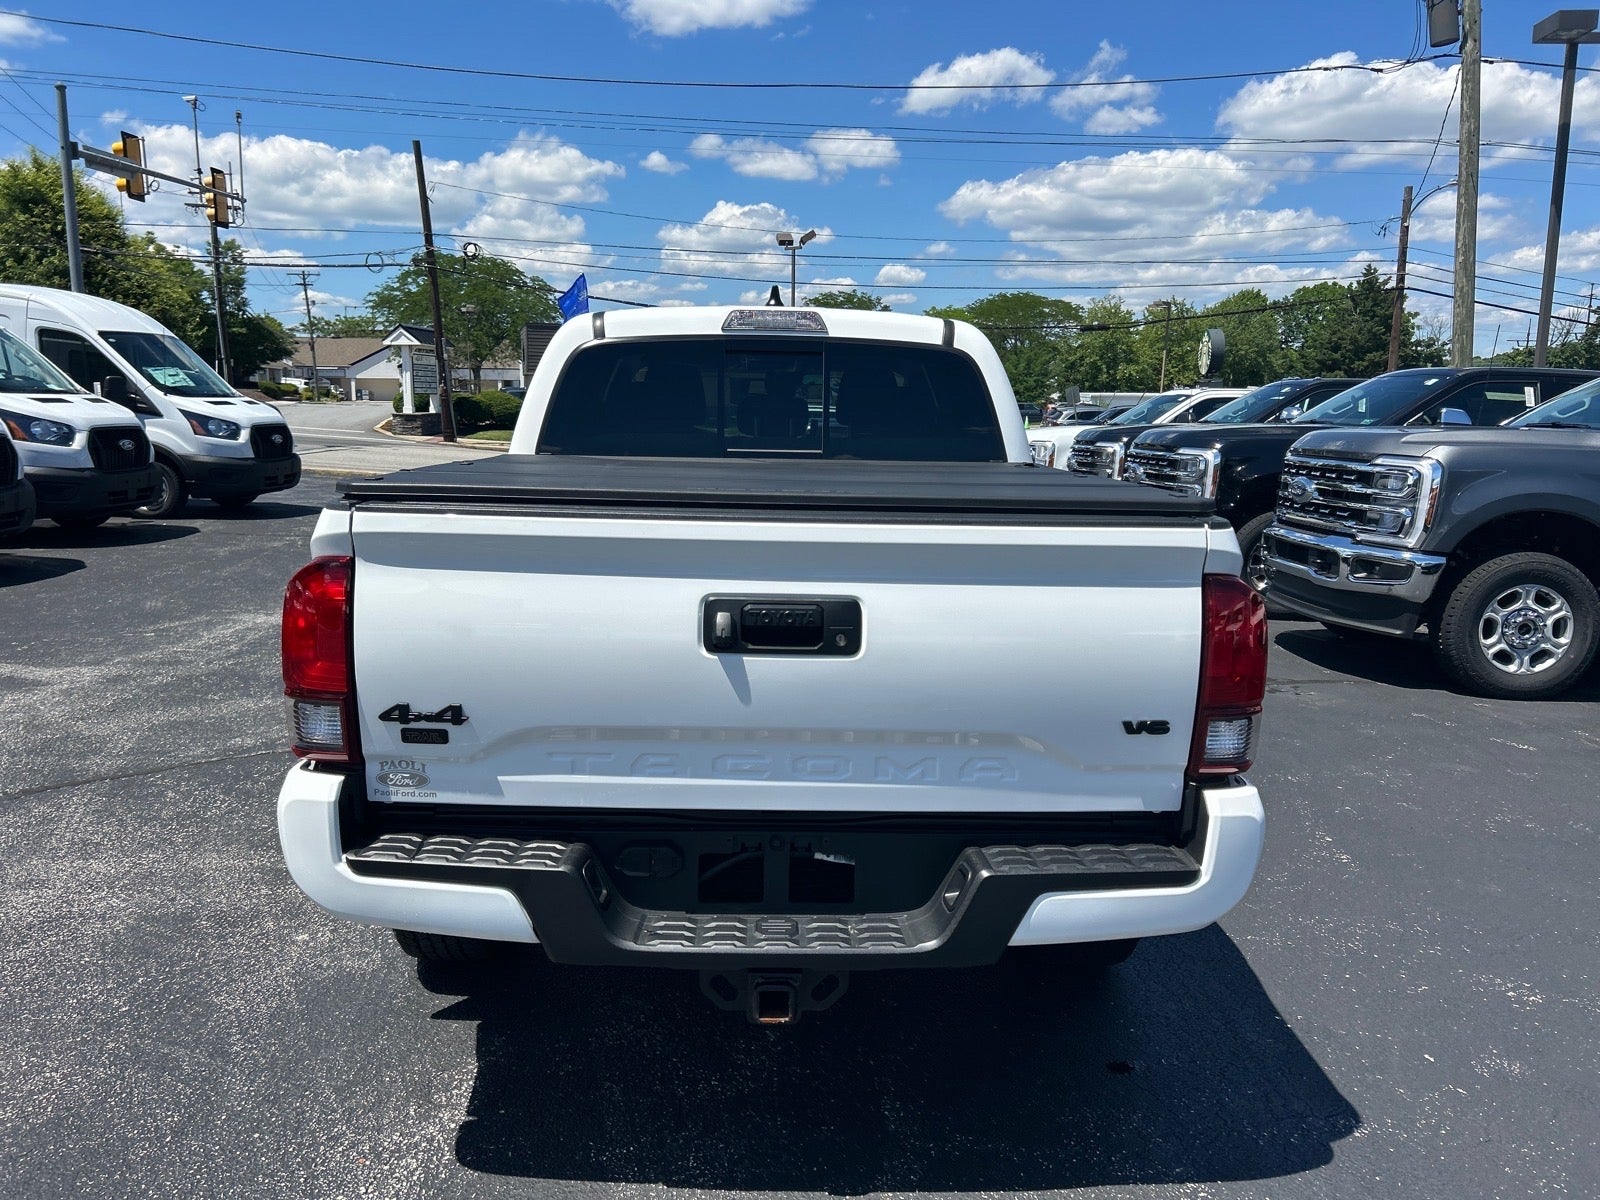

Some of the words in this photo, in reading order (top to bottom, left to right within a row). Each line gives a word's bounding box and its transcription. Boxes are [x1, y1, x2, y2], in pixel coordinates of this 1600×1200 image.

[749, 610, 815, 625] TOYOTA
[1122, 719, 1170, 735] V6
[405, 731, 443, 743] TRAIL
[379, 759, 427, 773] PAOLI
[546, 752, 1020, 783] TACOMA
[387, 773, 419, 786] Ford
[374, 788, 437, 798] PaoliFord.com
